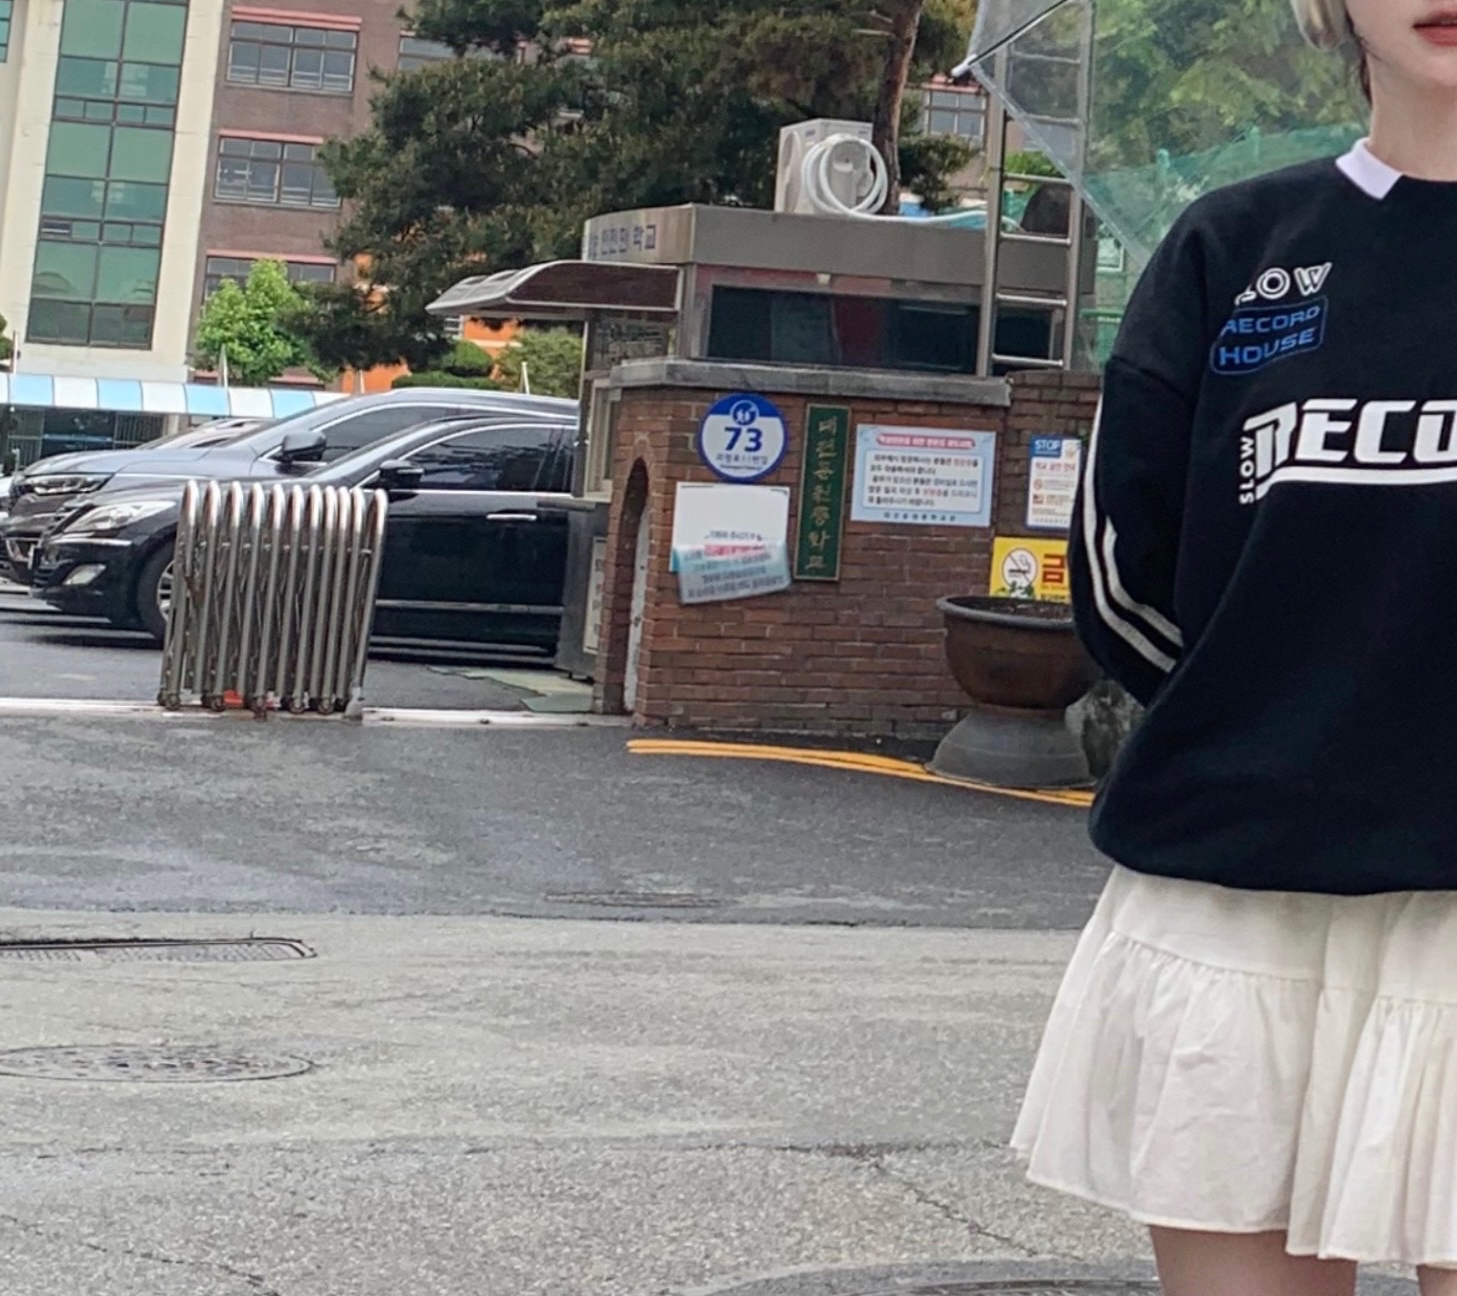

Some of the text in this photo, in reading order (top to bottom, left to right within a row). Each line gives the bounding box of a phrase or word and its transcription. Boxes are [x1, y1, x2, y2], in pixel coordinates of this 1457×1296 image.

[1220, 305, 1320, 337] RECORD
[1219, 327, 1316, 366] HOUSE
[724, 426, 763, 452] 73
[1034, 438, 1061, 451] STOP
[1239, 436, 1254, 504] SLOW
